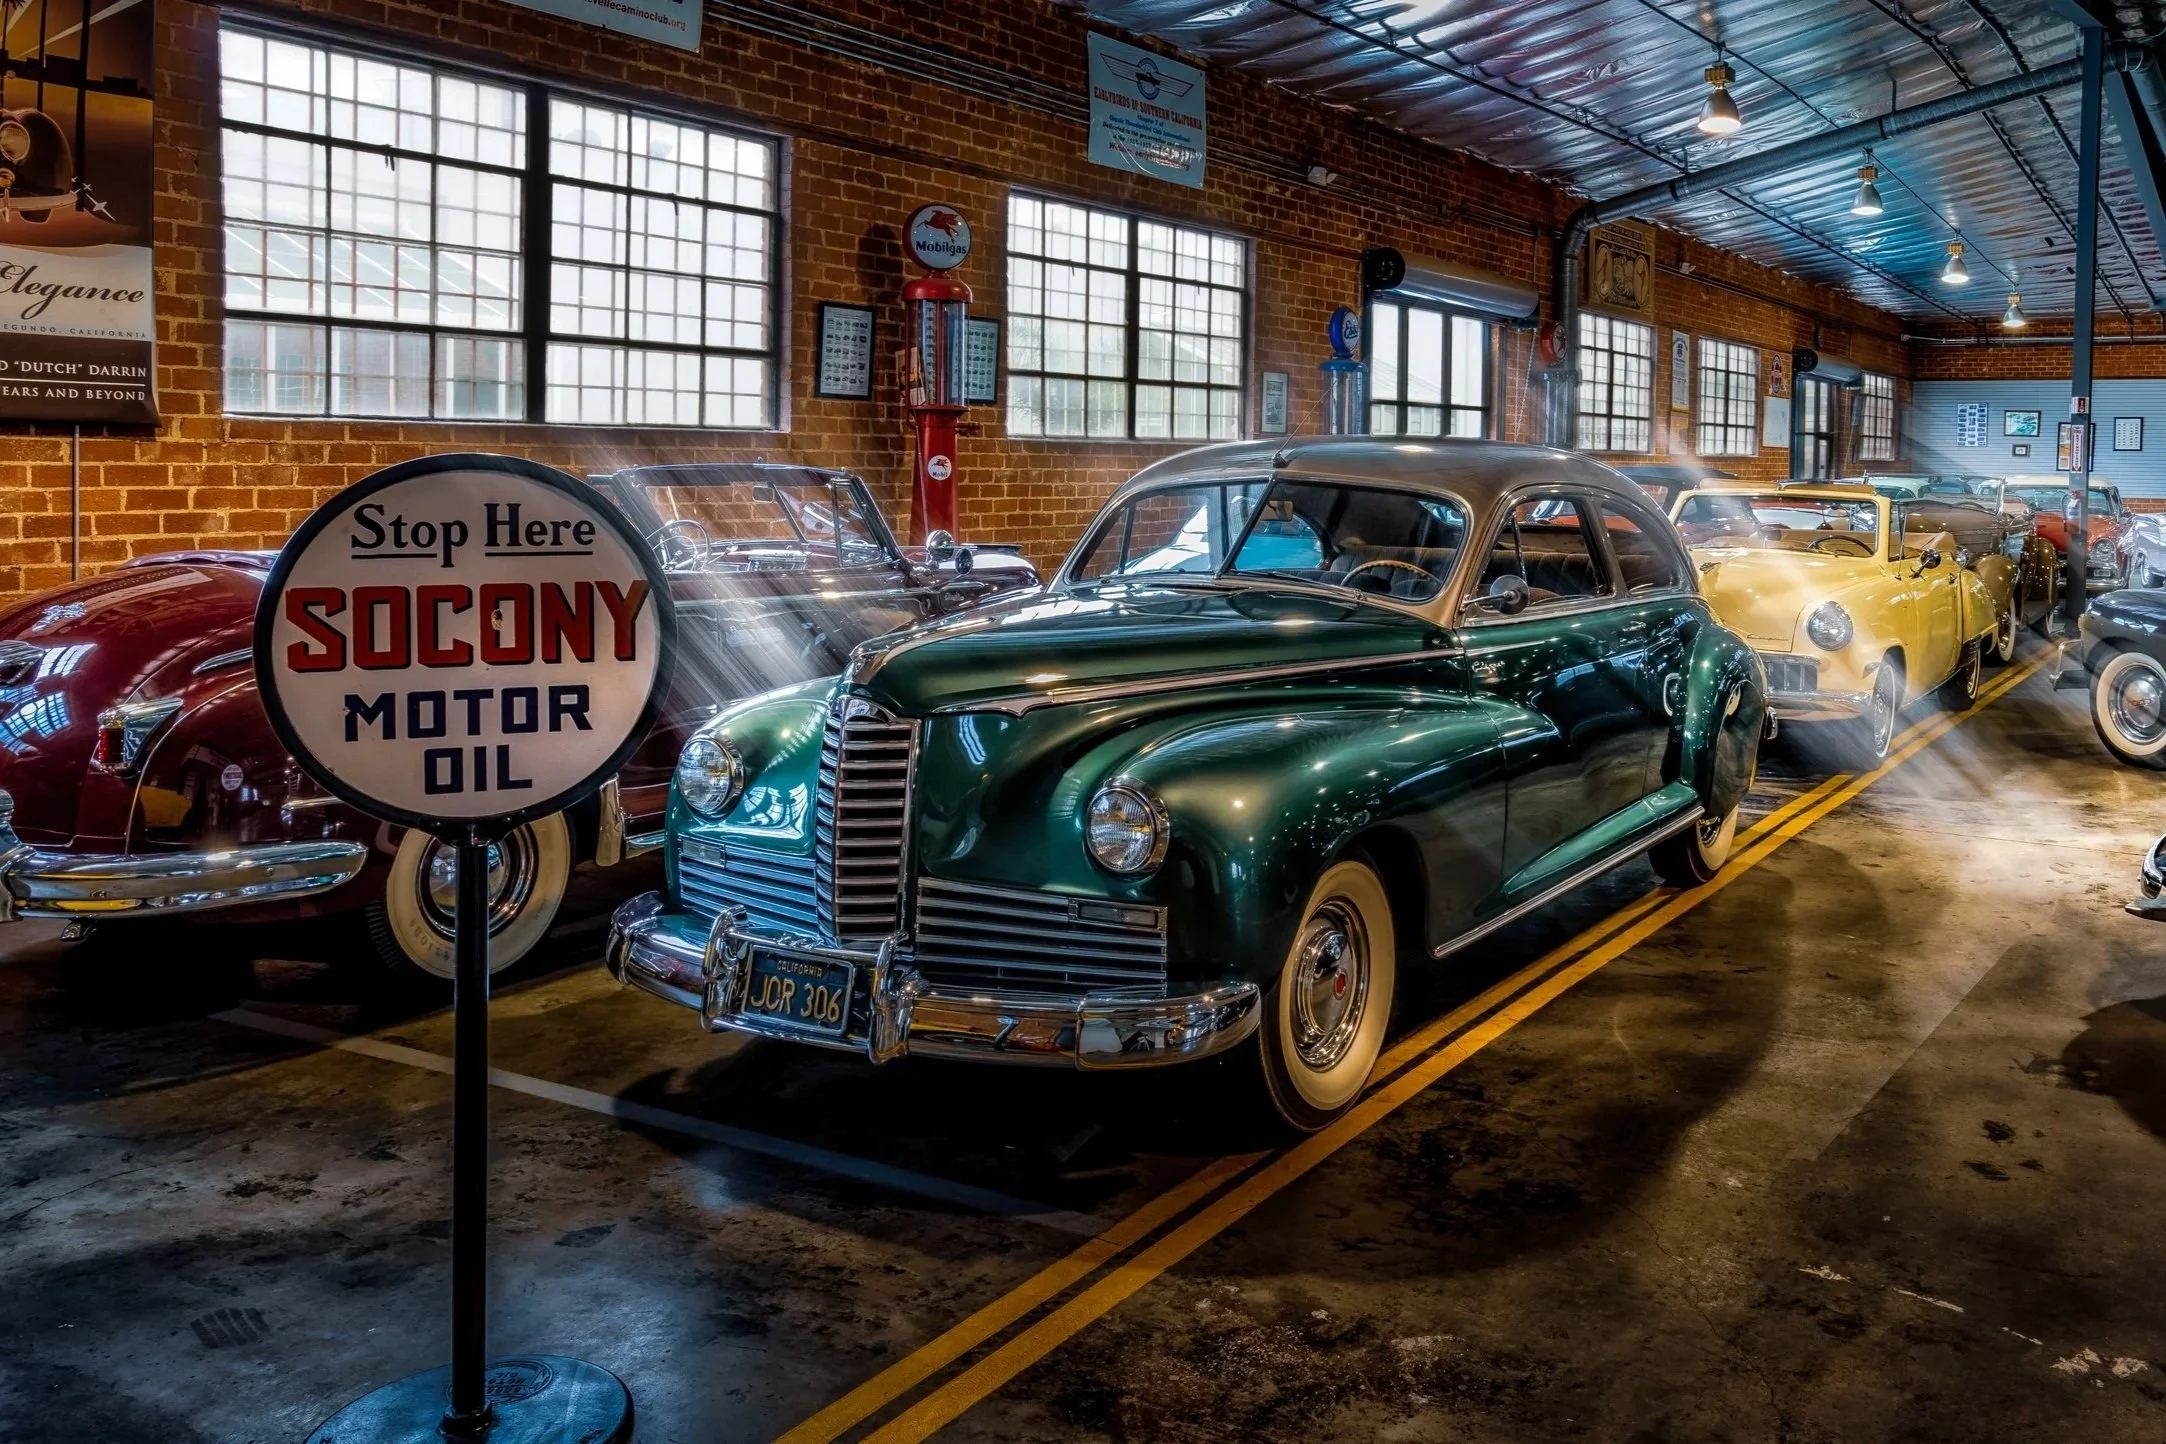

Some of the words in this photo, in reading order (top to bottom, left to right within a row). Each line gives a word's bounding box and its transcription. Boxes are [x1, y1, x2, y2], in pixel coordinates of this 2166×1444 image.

[1171, 110, 1203, 130] CALIFORNIA
[916, 240, 966, 256] Mobilgas
[0, 261, 144, 320] Elegance
[3, 323, 62, 334] EGUNDO,
[69, 327, 147, 338] CALIFORNIA
[88, 364, 146, 377] DARRIN
[2, 385, 39, 397] EARS
[45, 388, 79, 399] AND
[86, 390, 145, 401] BEYOND
[351, 503, 469, 568] Stop
[484, 503, 596, 547] Here
[285, 580, 654, 673] SOCONY
[344, 684, 594, 742] MOTOR
[424, 744, 533, 795] OIL
[776, 959, 824, 977] CALIFORNIA
[750, 974, 796, 1015] JOR
[800, 983, 843, 1023] 306
